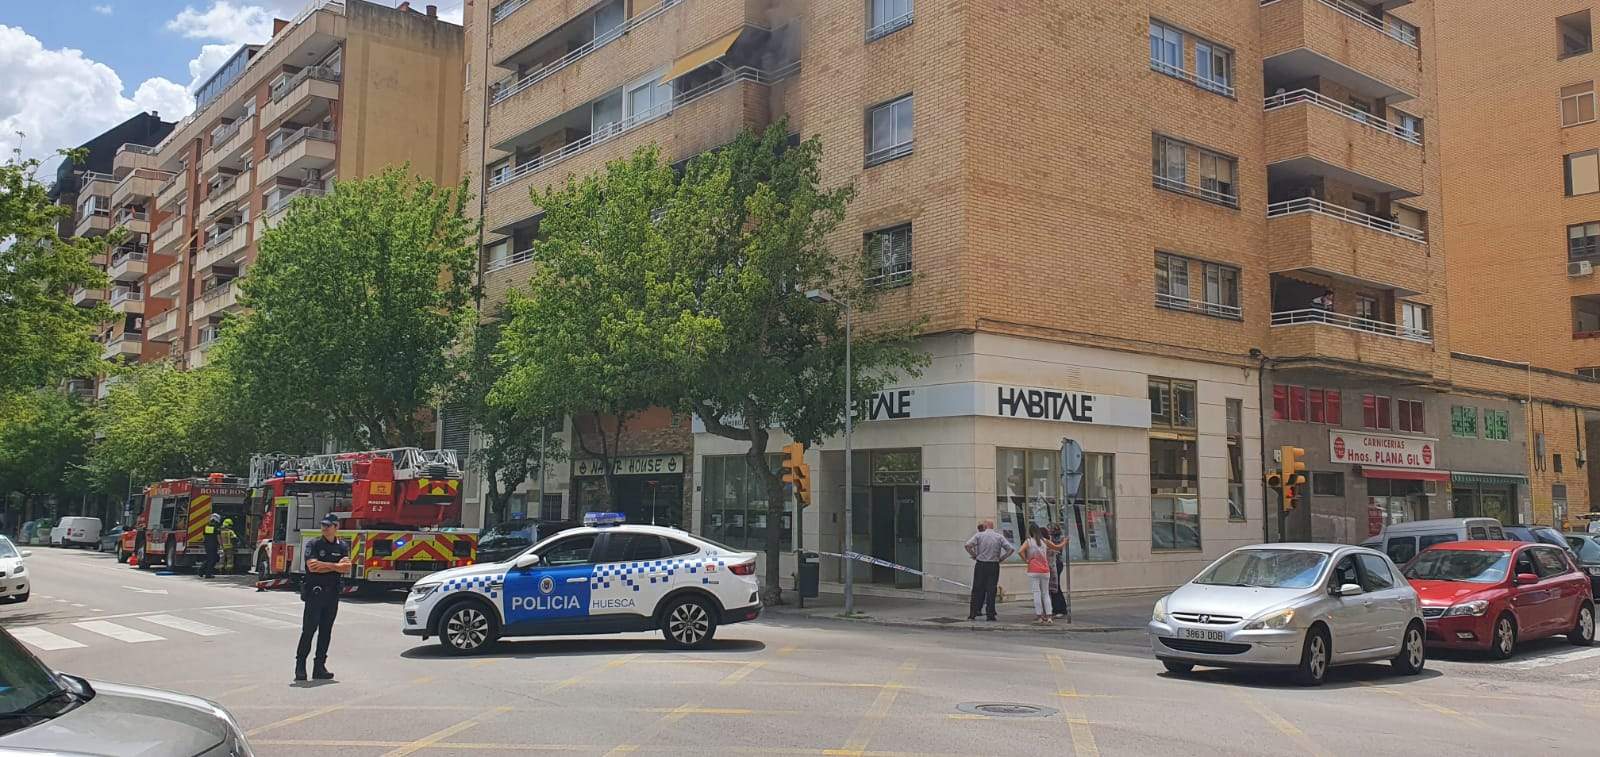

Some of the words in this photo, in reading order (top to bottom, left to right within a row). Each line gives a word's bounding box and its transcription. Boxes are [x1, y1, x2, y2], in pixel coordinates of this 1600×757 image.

[998, 387, 1093, 422] HABITALE
[1363, 438, 1405, 449] CARNICERIAS
[1347, 449, 1372, 462] Hnos.
[1375, 451, 1404, 465] PLANA
[1407, 454, 1420, 466] GIL
[591, 460, 622, 474] NAR
[628, 459, 662, 473] HOUSE
[200, 487, 248, 496] BOMBEROS
[592, 598, 636, 609] HUESCA
[1185, 629, 1205, 639] 3863
